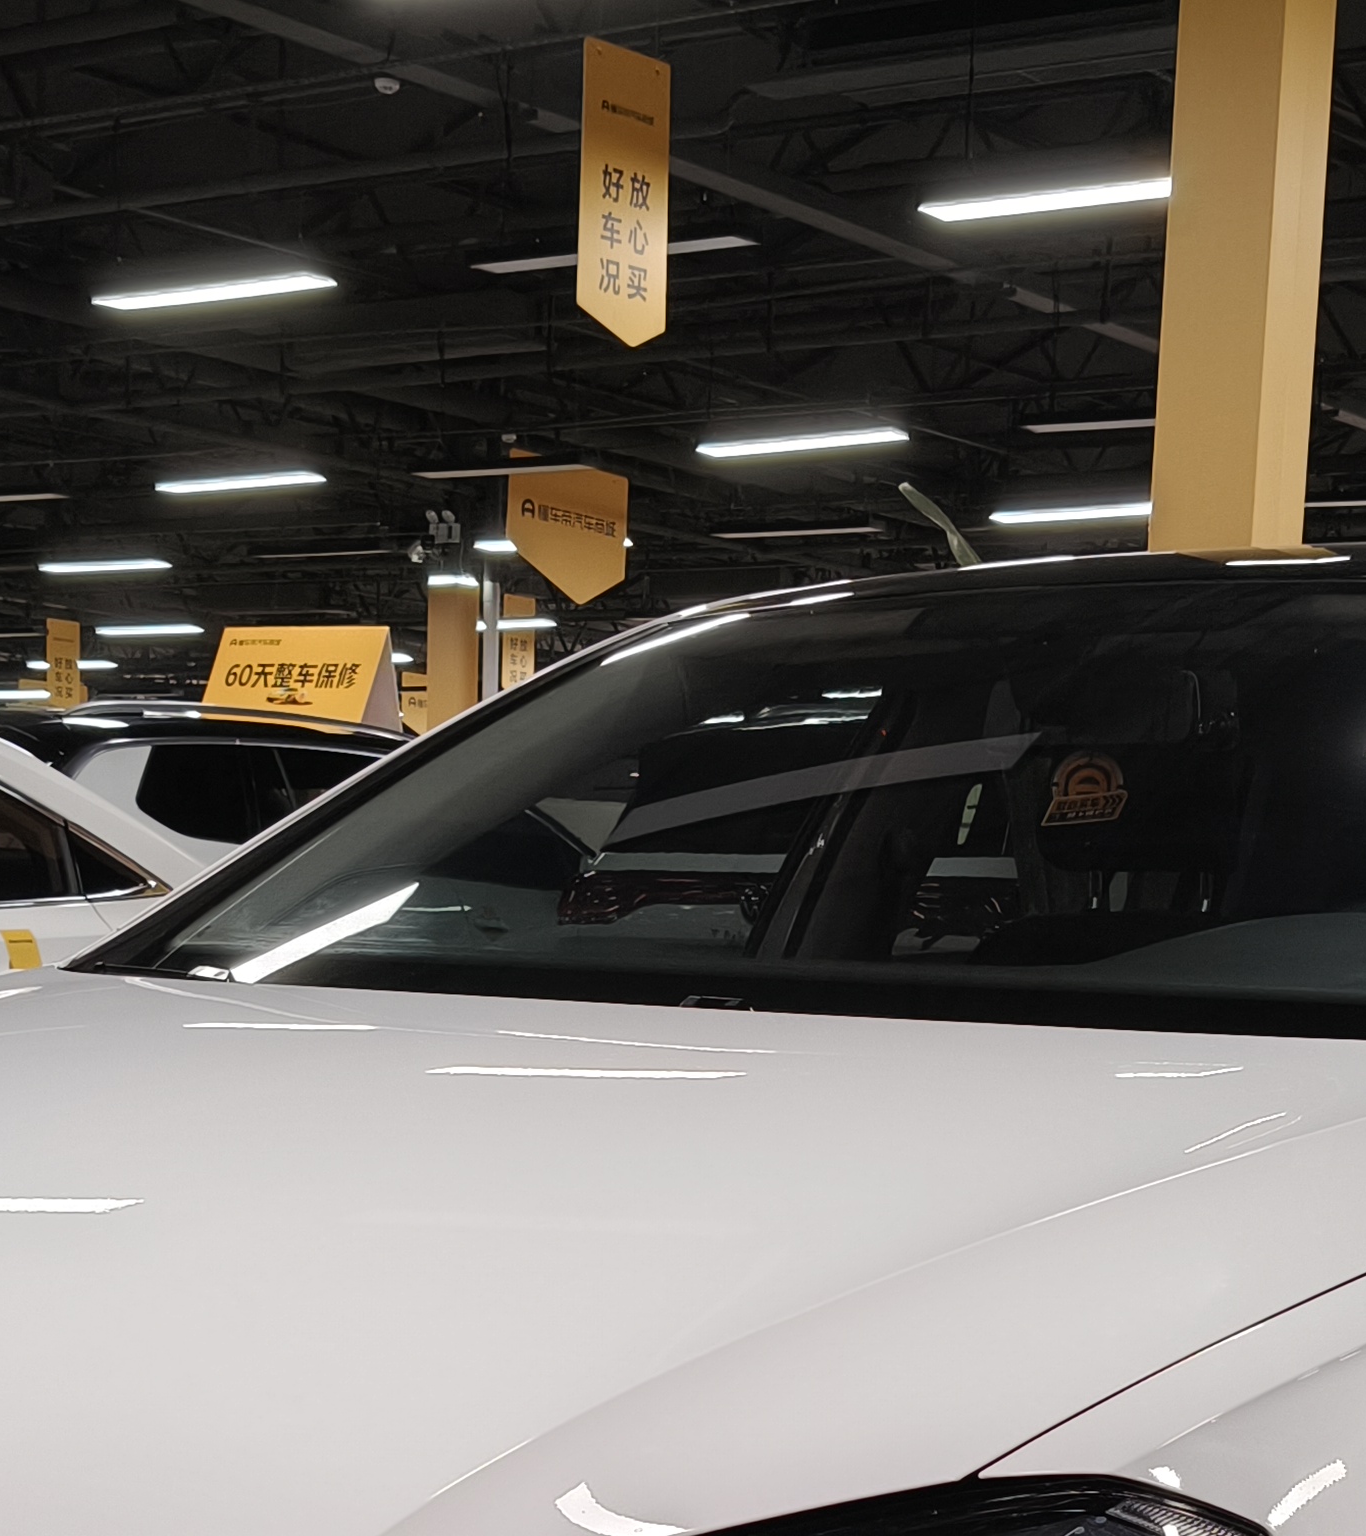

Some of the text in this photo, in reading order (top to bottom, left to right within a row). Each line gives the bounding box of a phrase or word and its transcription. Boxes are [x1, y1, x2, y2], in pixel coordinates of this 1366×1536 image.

[598, 164, 624, 296] 好车况
[627, 172, 651, 302] 放心买
[225, 662, 362, 689] 60天整车保修
